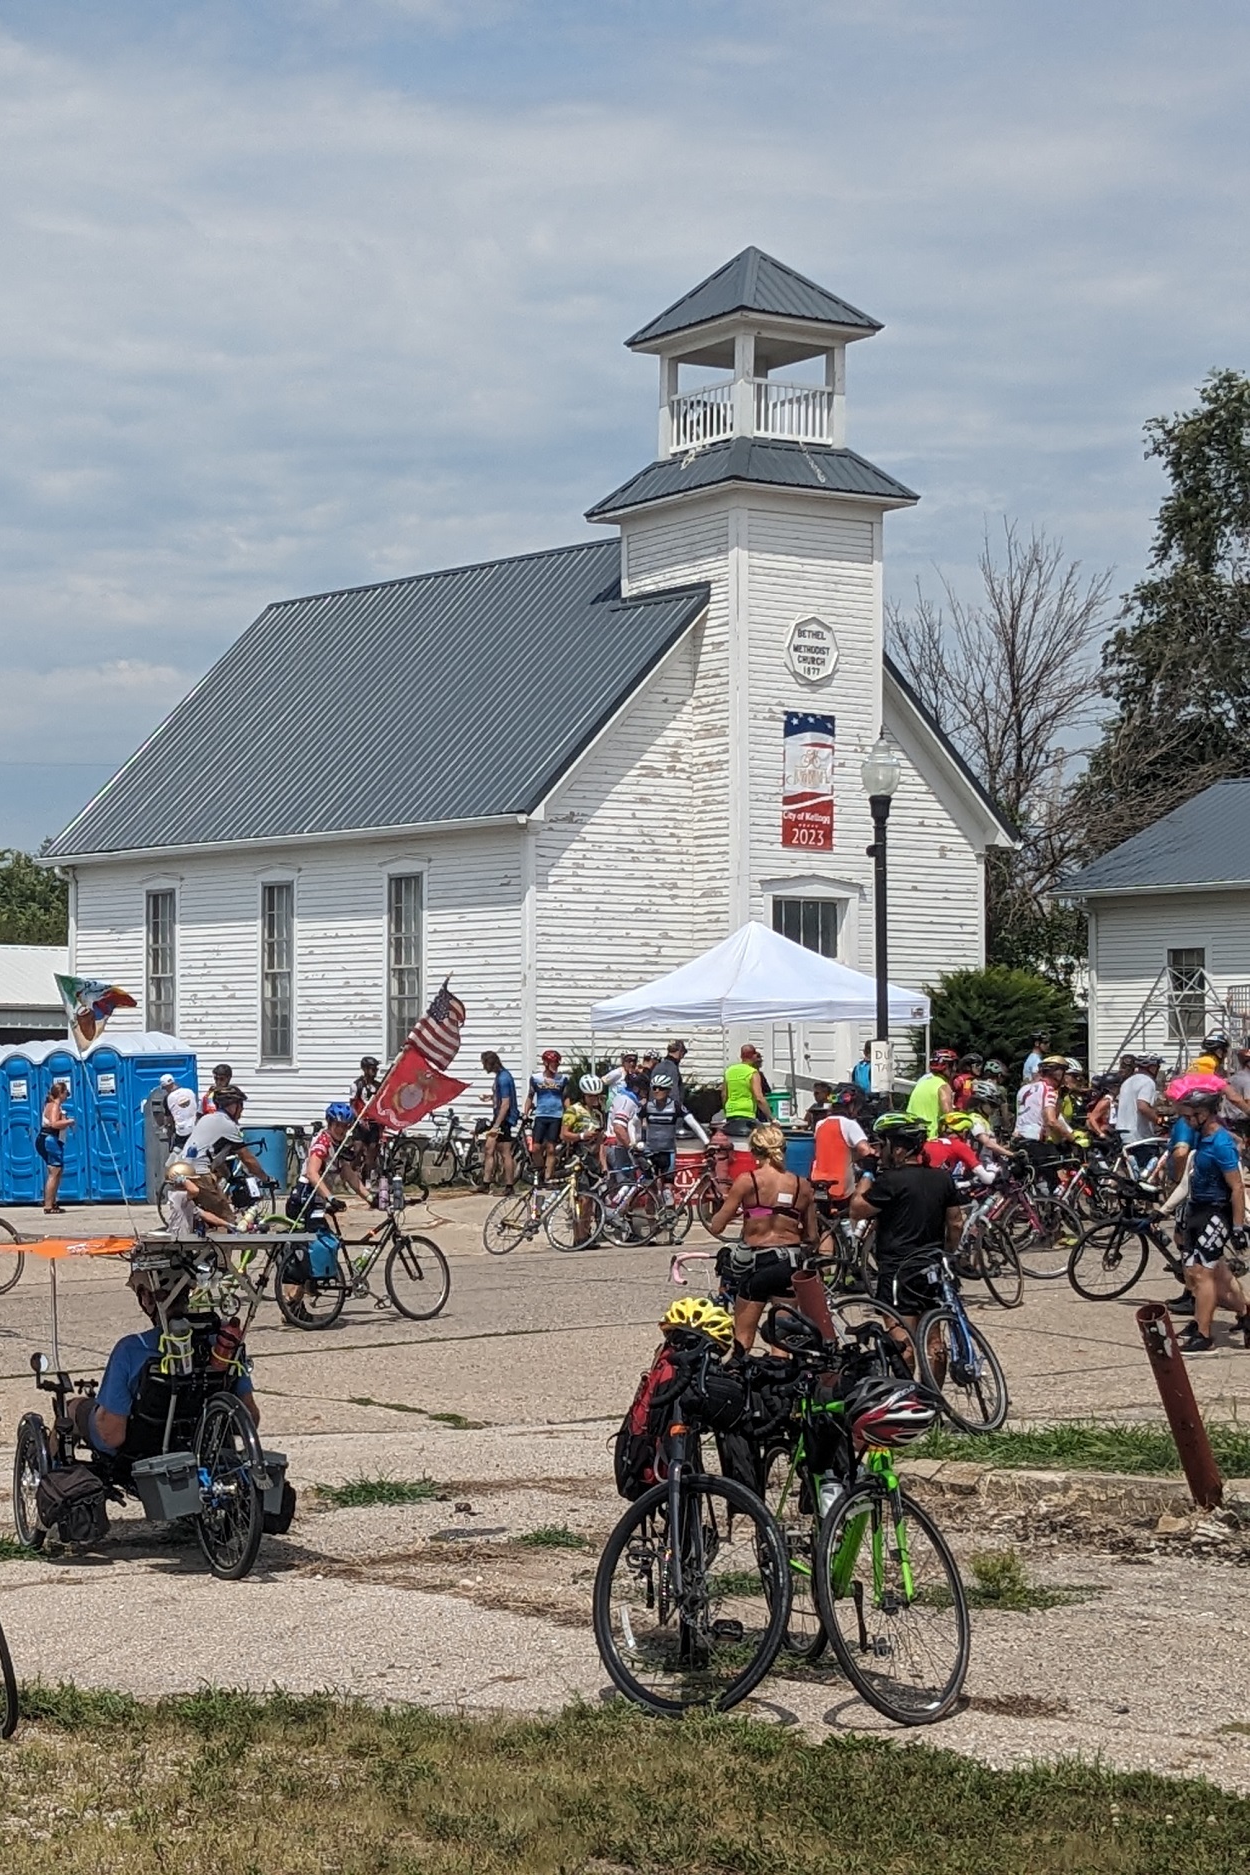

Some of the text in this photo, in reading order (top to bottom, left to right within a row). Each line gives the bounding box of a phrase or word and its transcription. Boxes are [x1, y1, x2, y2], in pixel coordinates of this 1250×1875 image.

[797, 629, 826, 641] BETHEL
[793, 644, 830, 656] METHODIST
[797, 655, 826, 667] CHURCH
[803, 666, 821, 676] 1877
[783, 811, 831, 825] City of Kellogg
[791, 828, 825, 846] 2023
